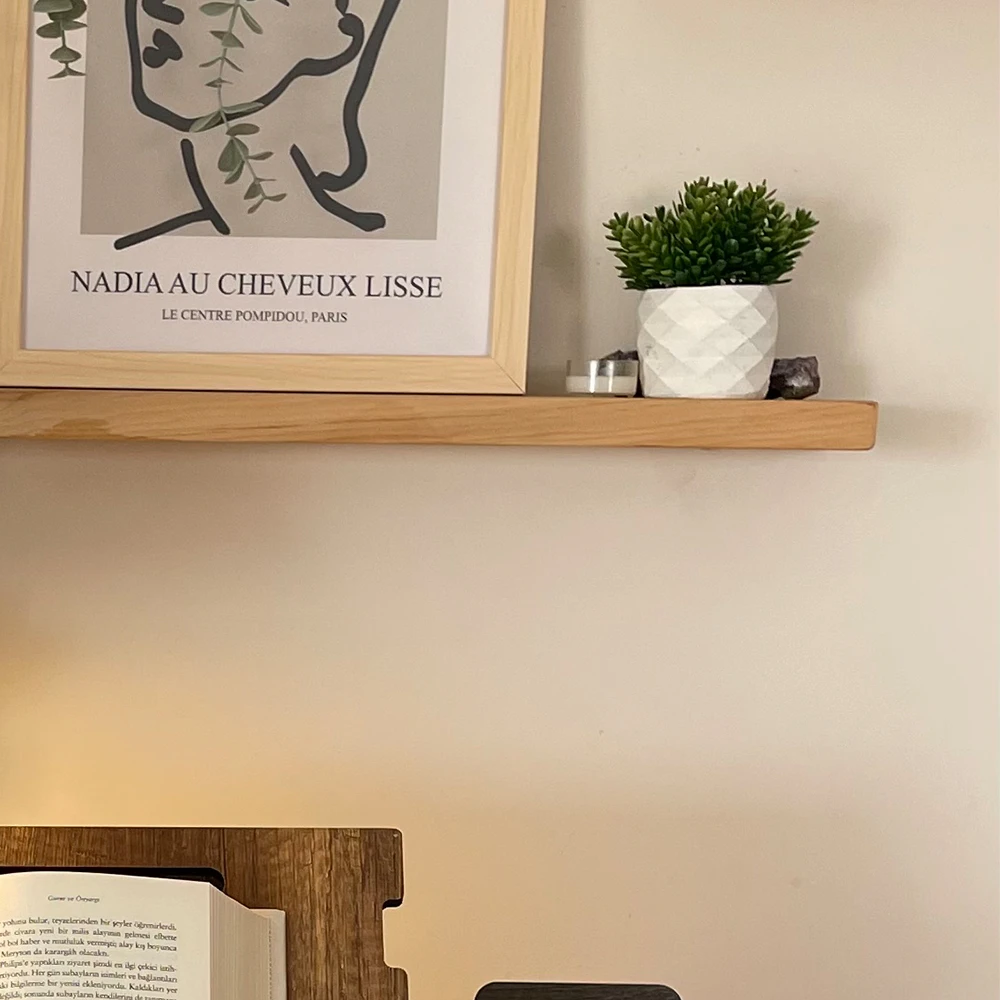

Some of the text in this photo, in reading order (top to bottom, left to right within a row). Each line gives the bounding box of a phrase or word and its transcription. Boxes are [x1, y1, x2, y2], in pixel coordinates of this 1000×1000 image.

[71, 270, 443, 298] NADIA AU CHEVEUX LISSE
[161, 308, 348, 324] LE CENTRE POMPIDOU, PARIS
